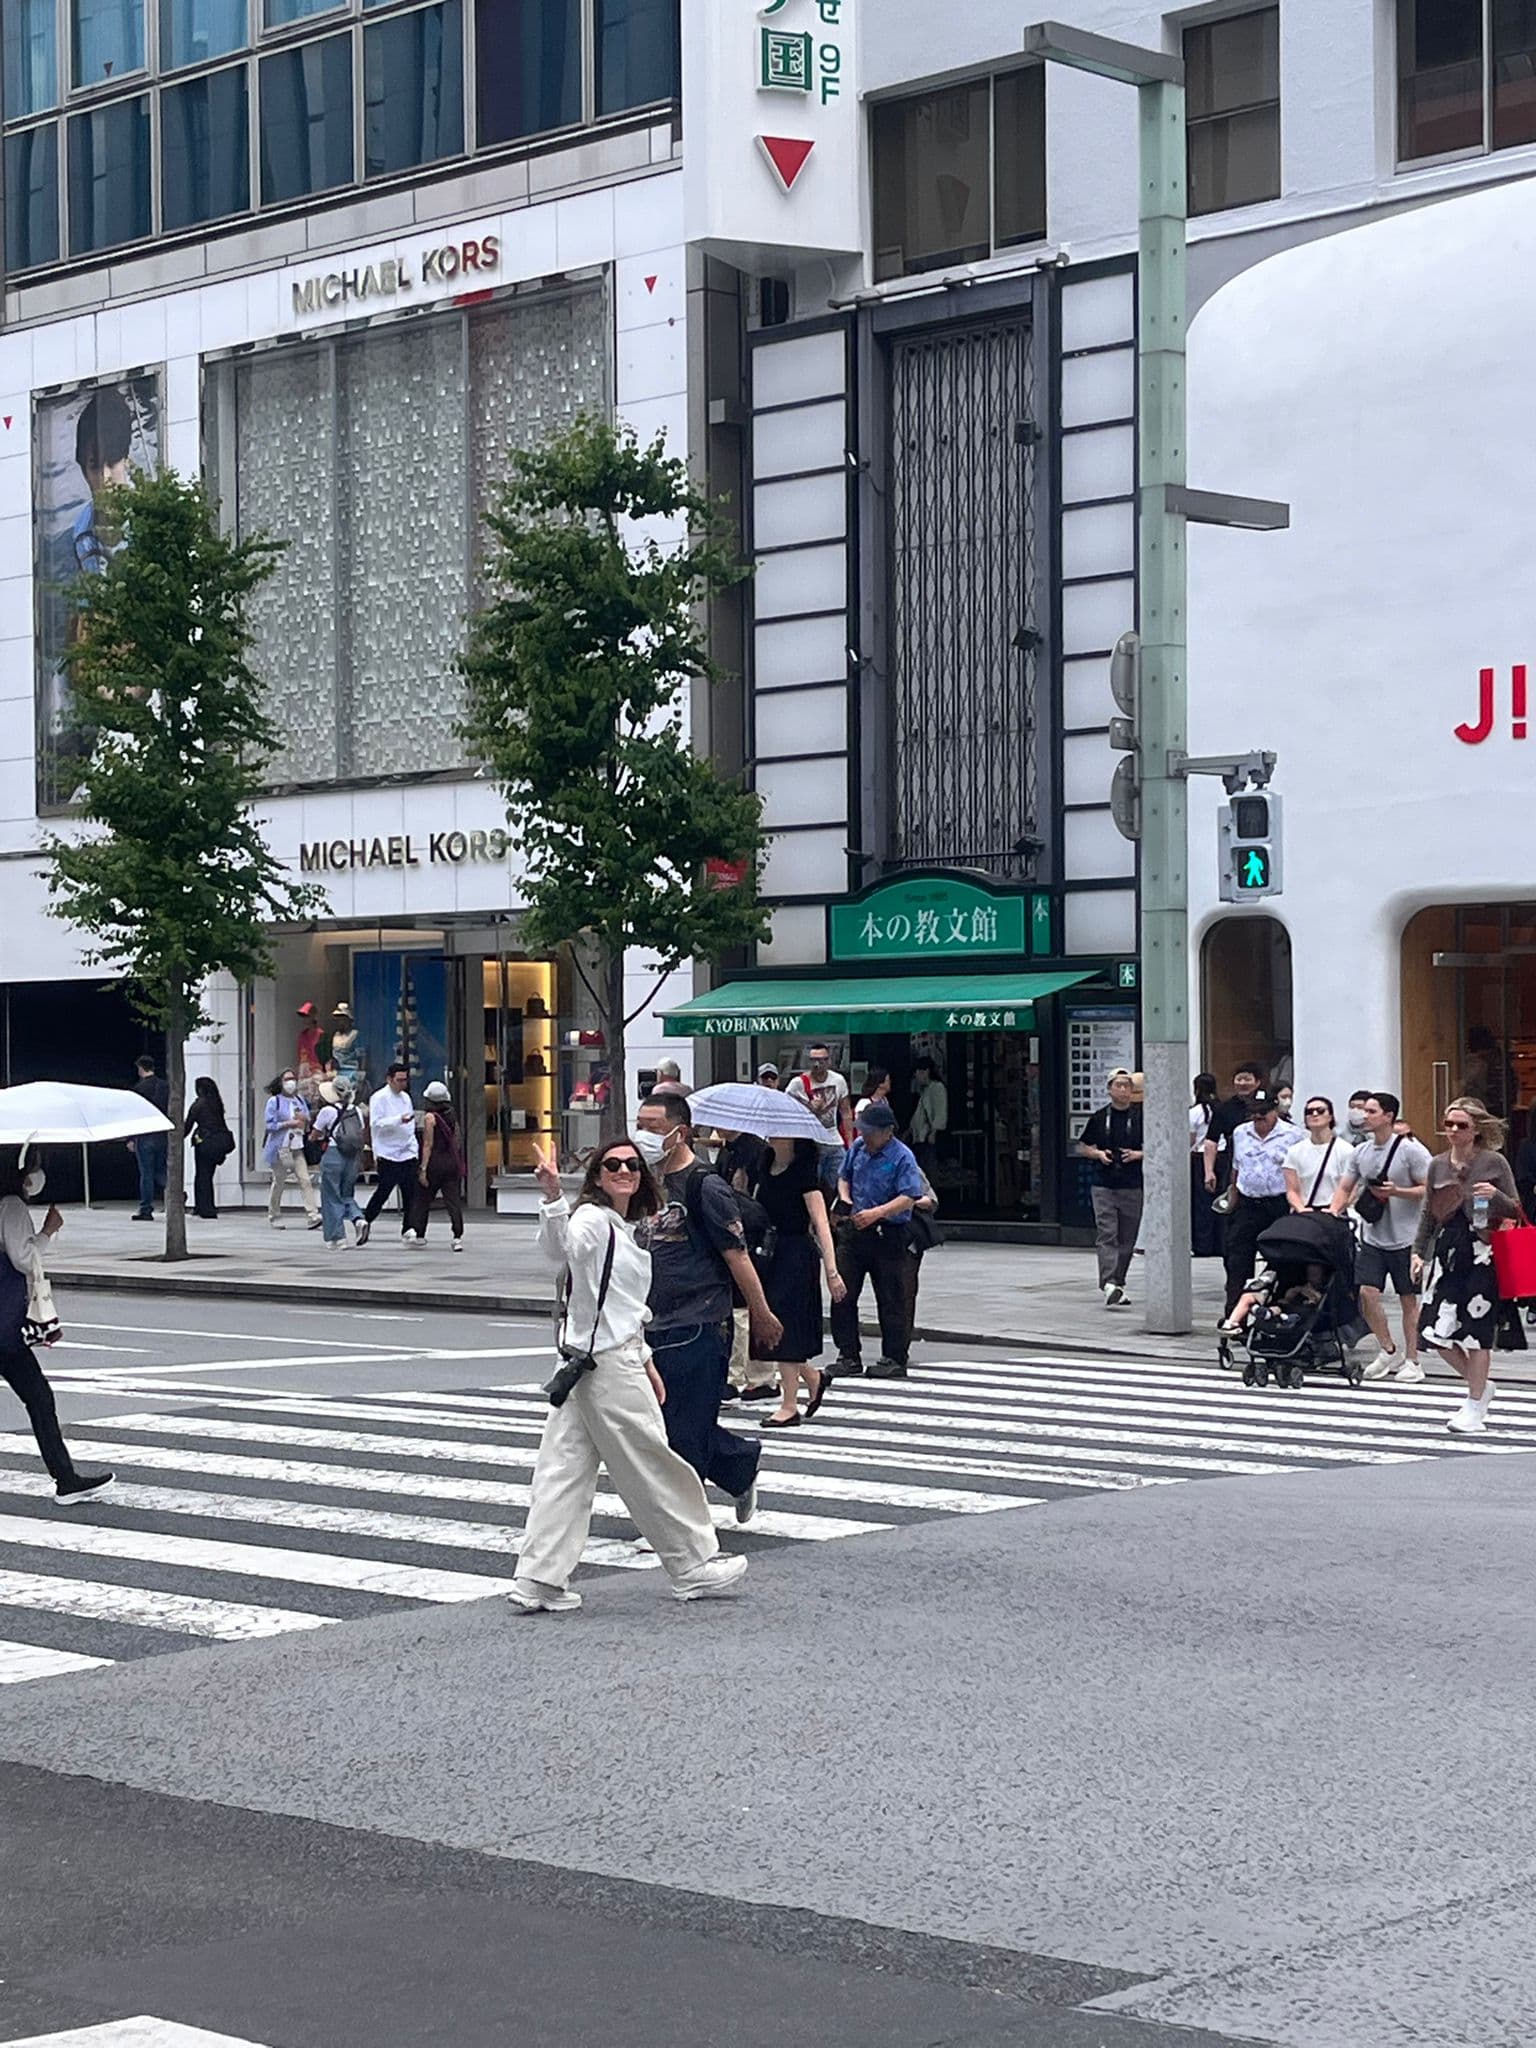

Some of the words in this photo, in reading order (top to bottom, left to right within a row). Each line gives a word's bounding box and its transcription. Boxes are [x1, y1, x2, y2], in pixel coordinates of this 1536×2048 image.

[761, 0, 813, 91] 国
[292, 257, 411, 313] MICHAEL
[421, 235, 500, 283] KORS
[299, 835, 418, 872] MICHAEL
[429, 828, 508, 863] KORS
[858, 905, 998, 948] 本の教文館
[704, 1015, 801, 1033] KYOBUNKWAN
[945, 1011, 1017, 1028] 本の教文館
